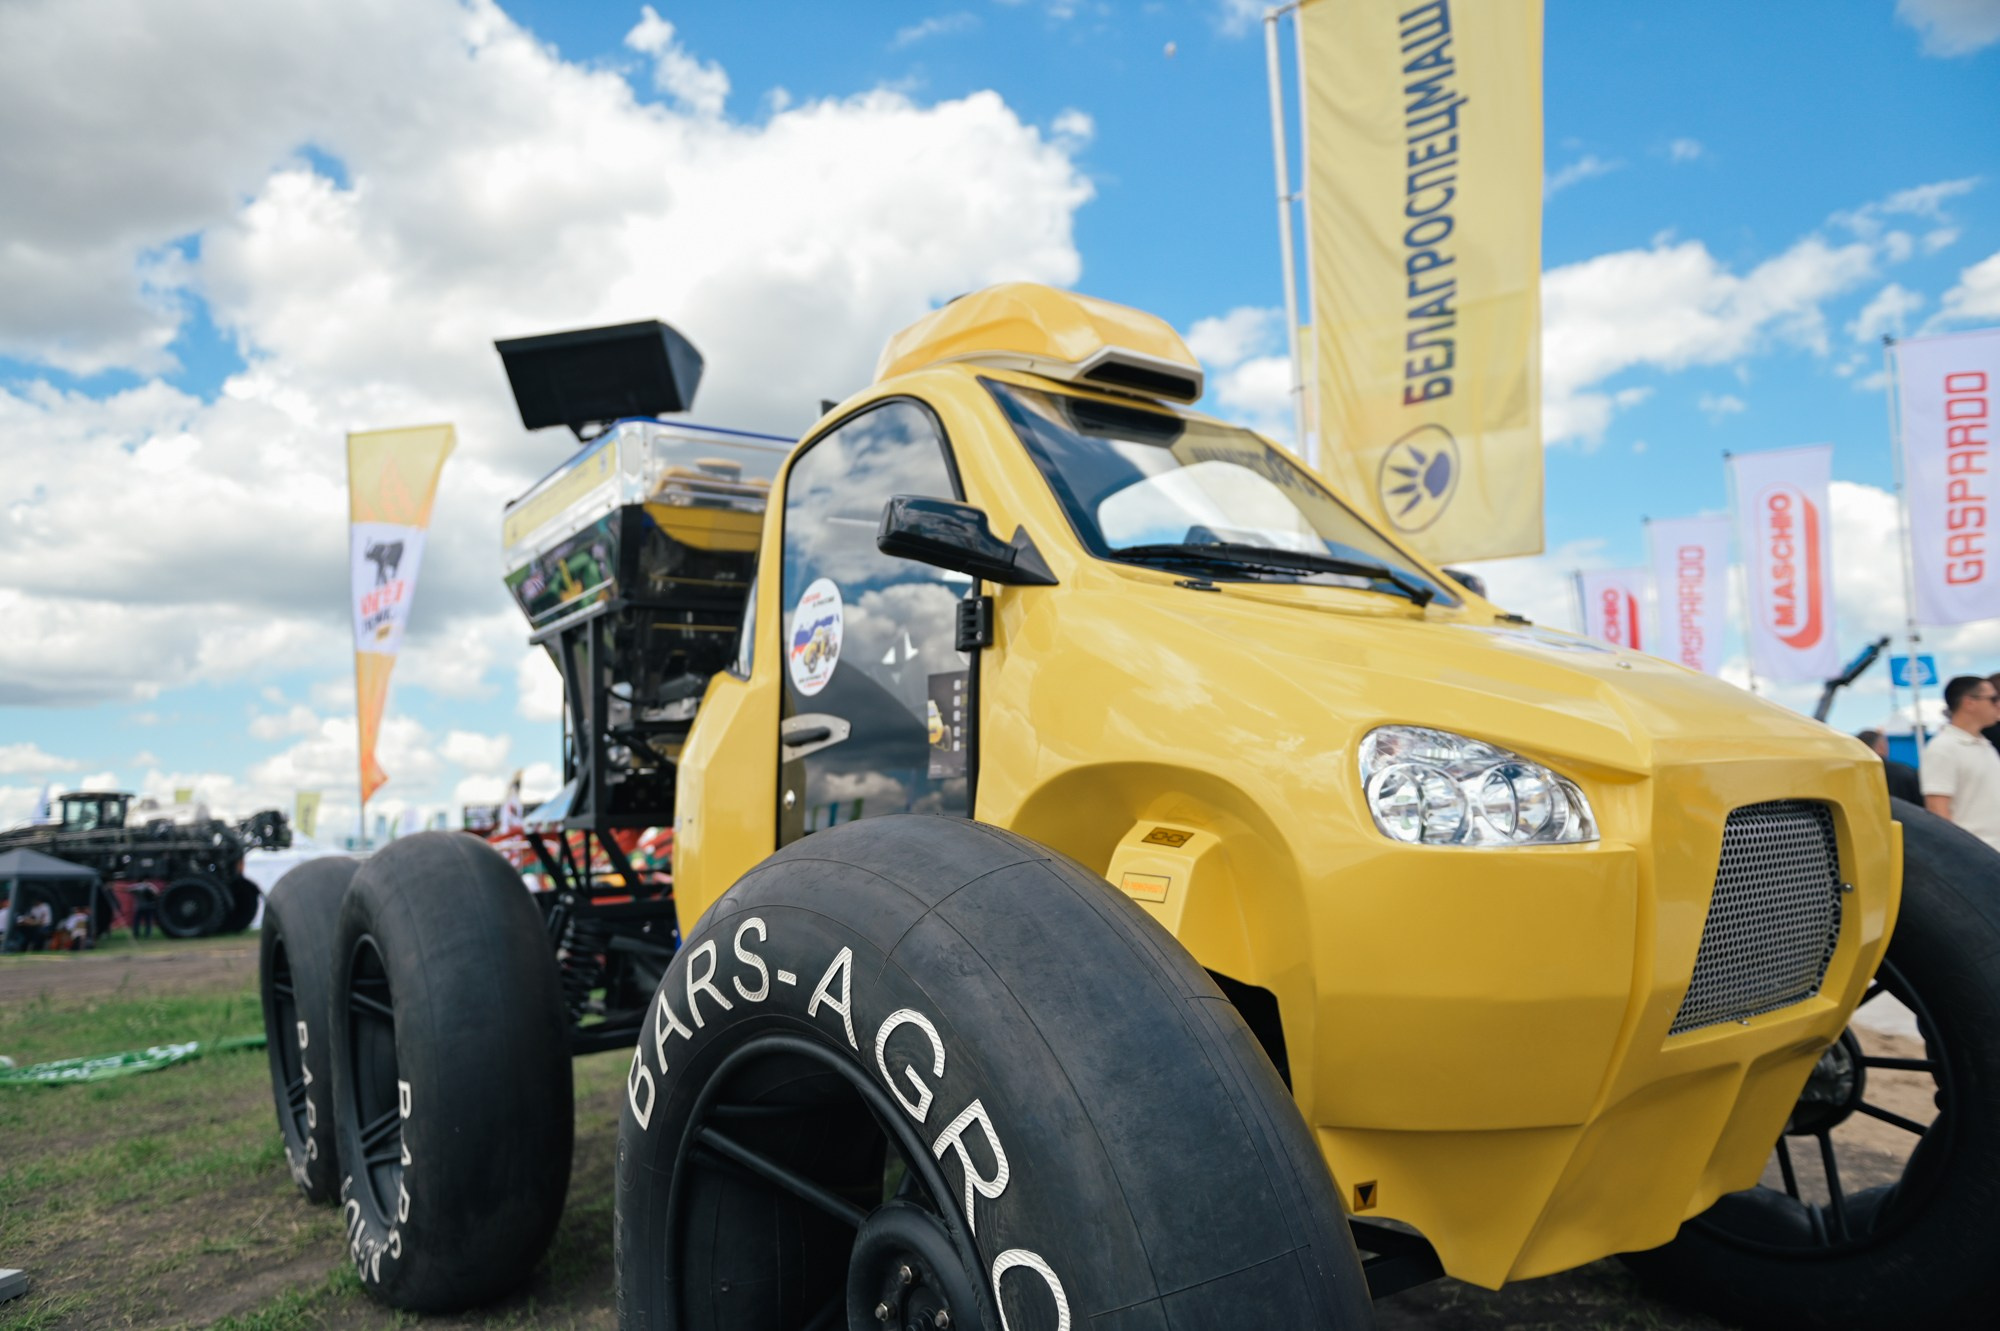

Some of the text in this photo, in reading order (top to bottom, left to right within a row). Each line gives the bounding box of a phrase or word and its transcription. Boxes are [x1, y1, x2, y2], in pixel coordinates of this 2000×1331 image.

[1398, 0, 1469, 406] БЕЛАГРОСПЕЦМАШ
[1768, 491, 1796, 627] MASCHIO
[1944, 371, 1988, 585] GASPARDO
